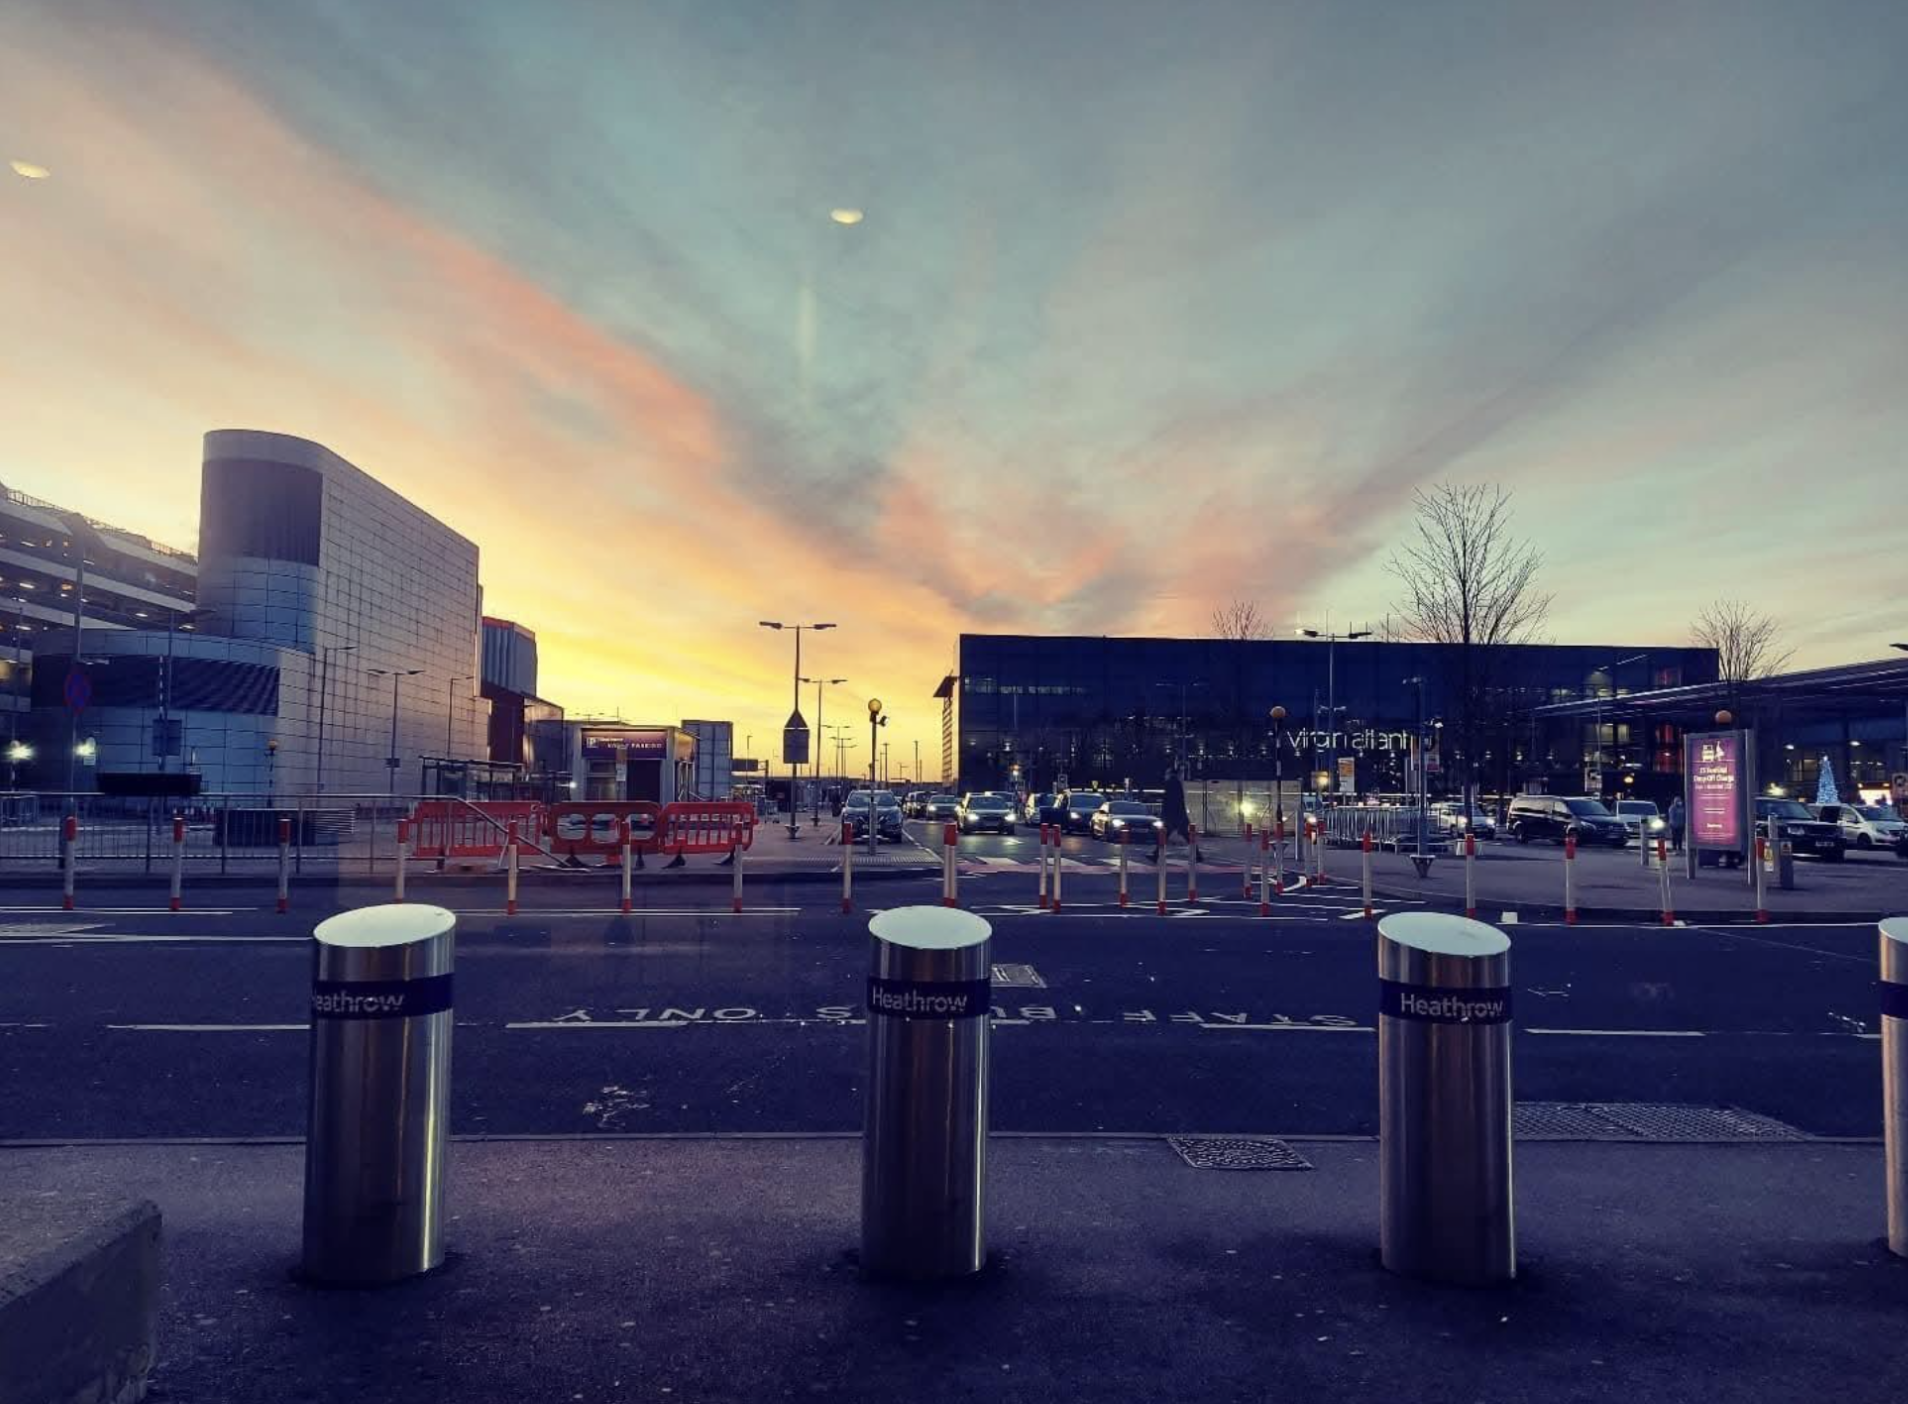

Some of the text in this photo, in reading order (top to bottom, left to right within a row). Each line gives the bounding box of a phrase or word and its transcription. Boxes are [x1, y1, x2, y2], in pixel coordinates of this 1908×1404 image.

[1352, 728, 1410, 750] atlant
[312, 990, 405, 1012] eathrow
[872, 985, 968, 1012] Heathrow
[1400, 992, 1504, 1018] Heathrow
[552, 1007, 757, 1021] ONLY
